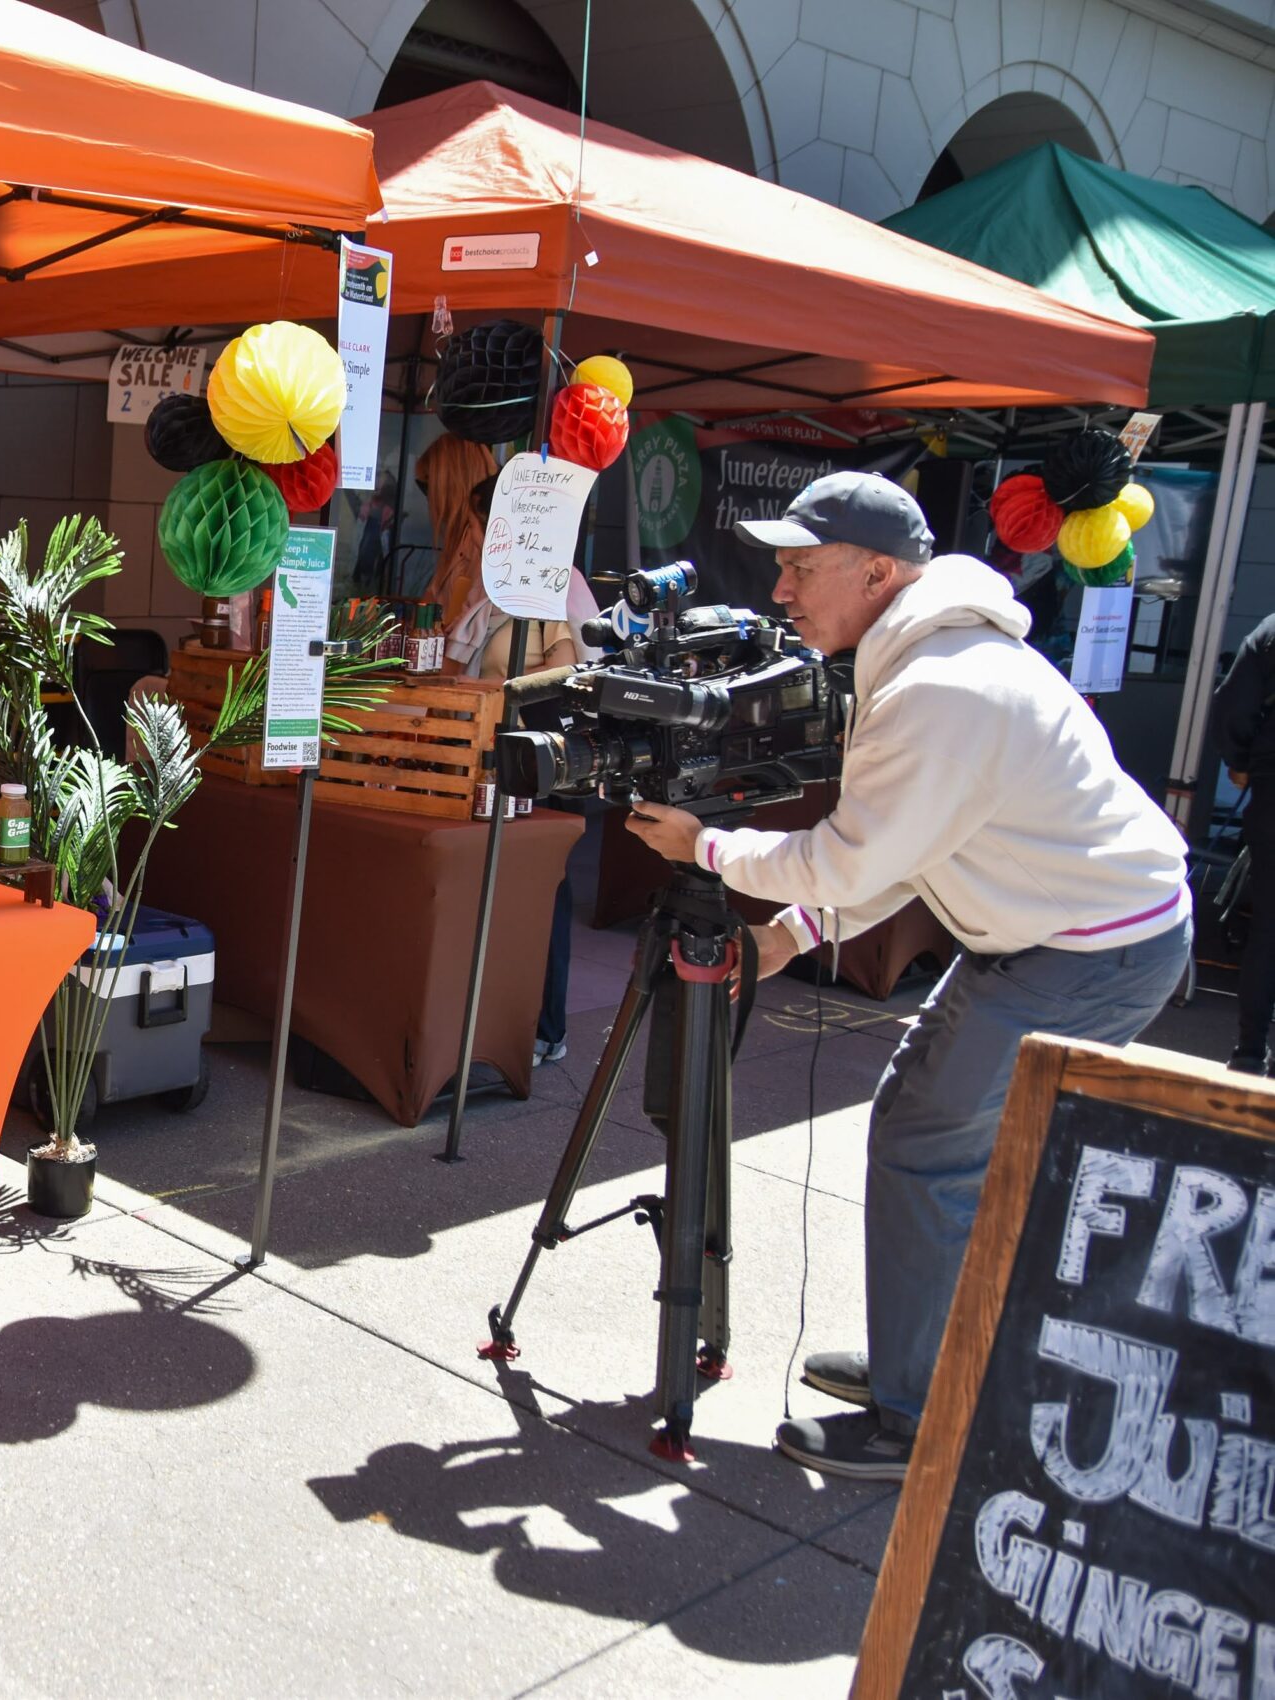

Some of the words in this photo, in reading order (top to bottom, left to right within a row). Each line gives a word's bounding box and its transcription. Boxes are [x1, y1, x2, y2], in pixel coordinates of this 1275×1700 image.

[121, 347, 200, 368] WELCOME
[352, 343, 371, 353] CLARK
[117, 363, 173, 387] SALE
[347, 360, 371, 379] Simple
[121, 391, 132, 412] 2
[794, 427, 823, 440] PLAZA
[635, 435, 661, 473] ERRY
[501, 457, 574, 495] JUNETEENTH
[302, 545, 309, 554] It
[486, 540, 513, 556] ITEMS
[516, 531, 540, 551] $12
[281, 556, 307, 569] Simple
[307, 558, 325, 569] Juice
[494, 562, 512, 589] 2
[623, 691, 639, 700] HD
[267, 742, 297, 751] Foodwise
